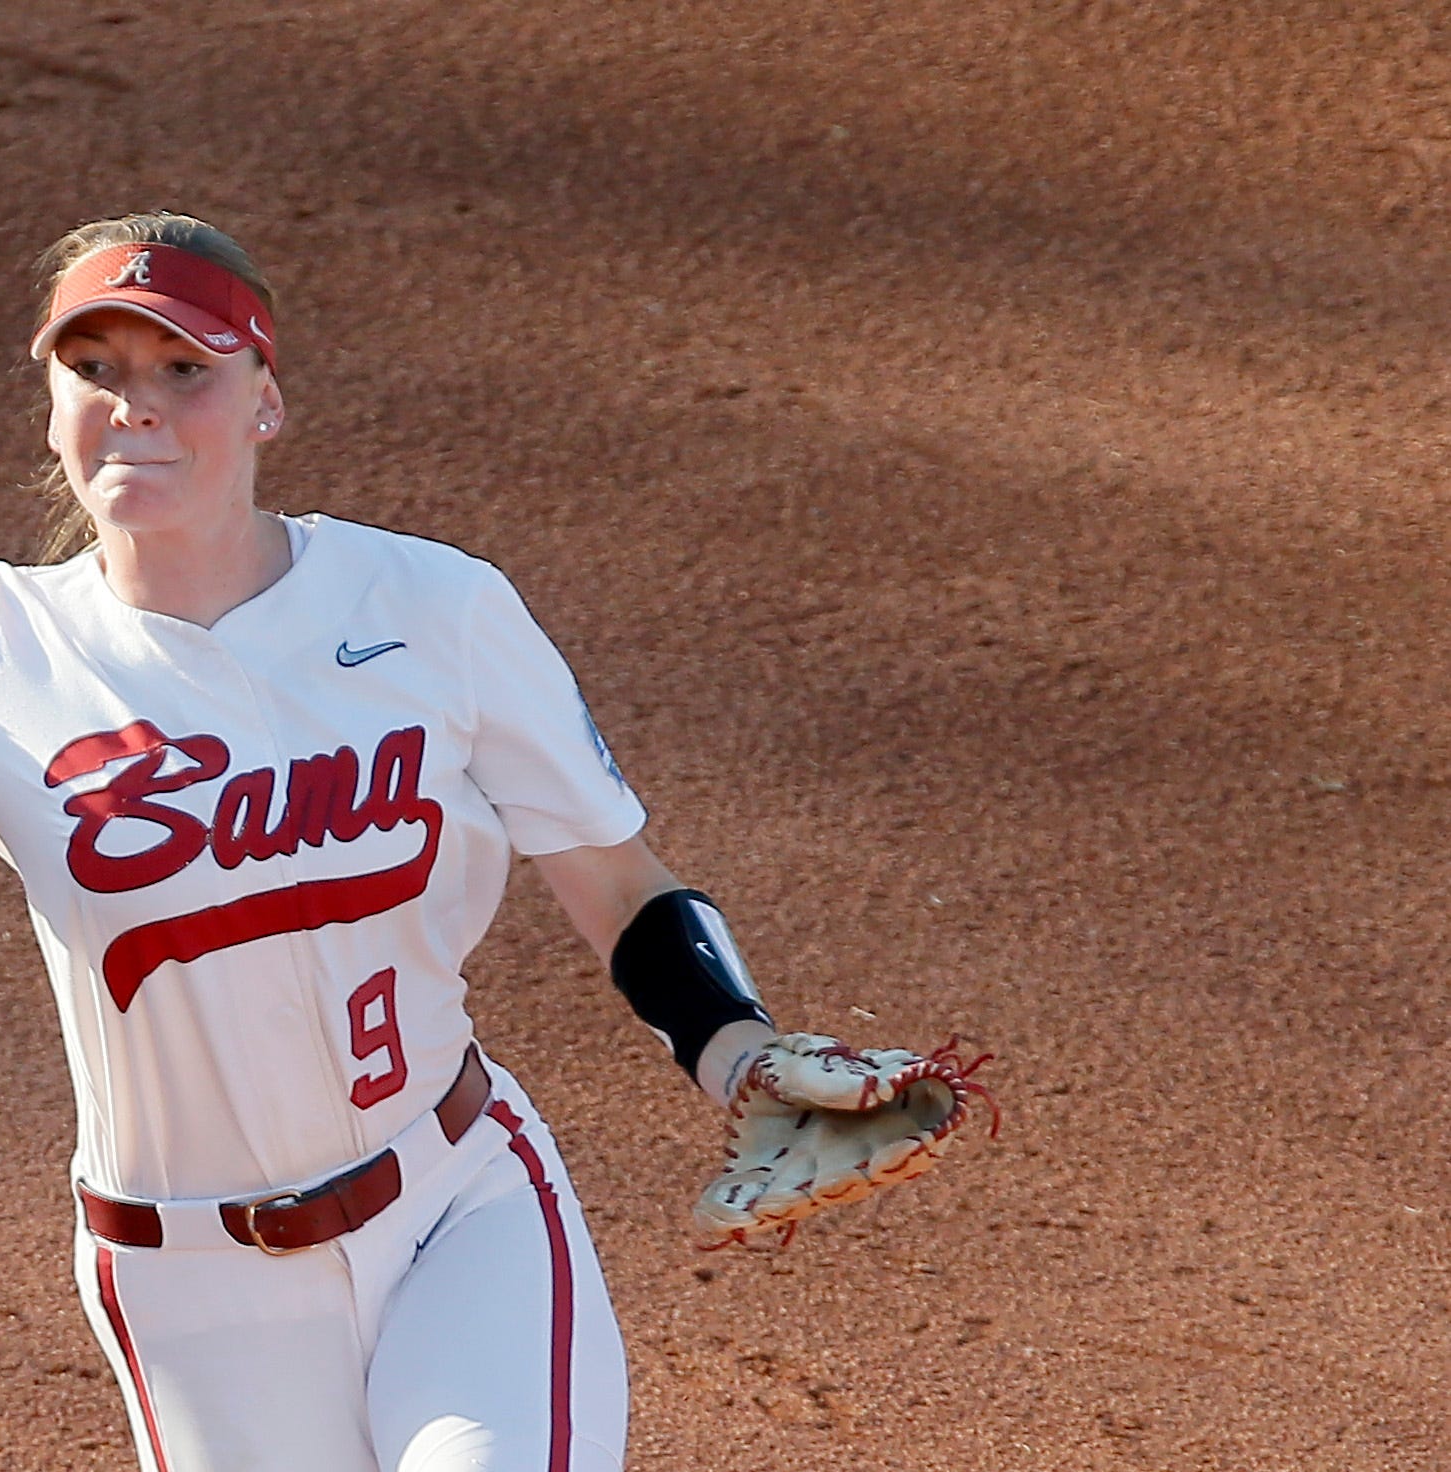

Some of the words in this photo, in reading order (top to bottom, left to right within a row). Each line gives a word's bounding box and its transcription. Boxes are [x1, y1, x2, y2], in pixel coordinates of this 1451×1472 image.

[105, 250, 151, 286] A
[45, 718, 443, 894] Bama
[348, 967, 405, 1110] 9
